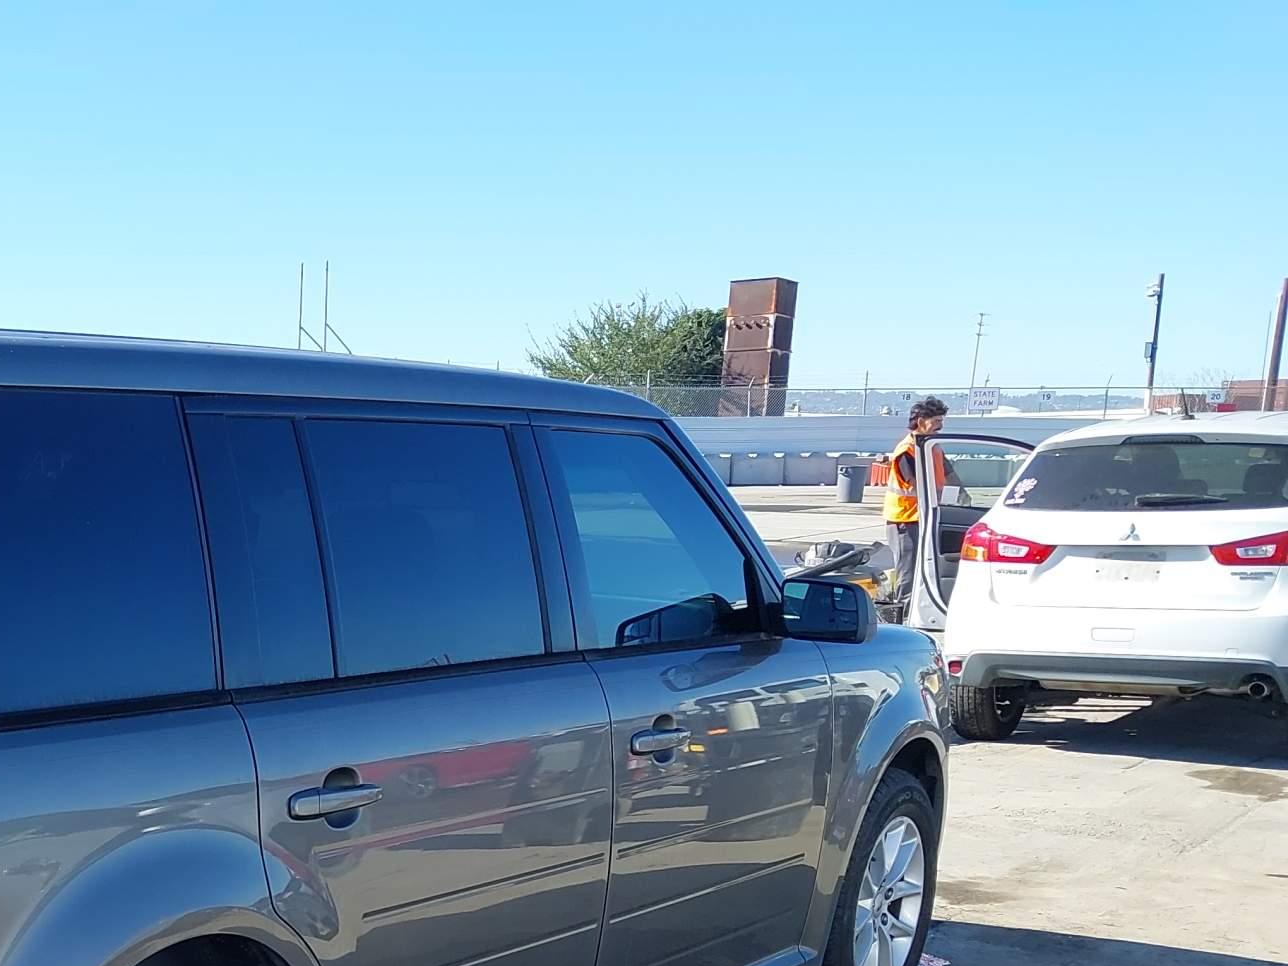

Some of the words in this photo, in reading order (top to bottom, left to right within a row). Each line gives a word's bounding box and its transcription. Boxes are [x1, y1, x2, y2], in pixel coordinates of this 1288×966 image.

[902, 393, 911, 401] 18
[1042, 393, 1052, 401] 19
[973, 399, 994, 407] FARM
